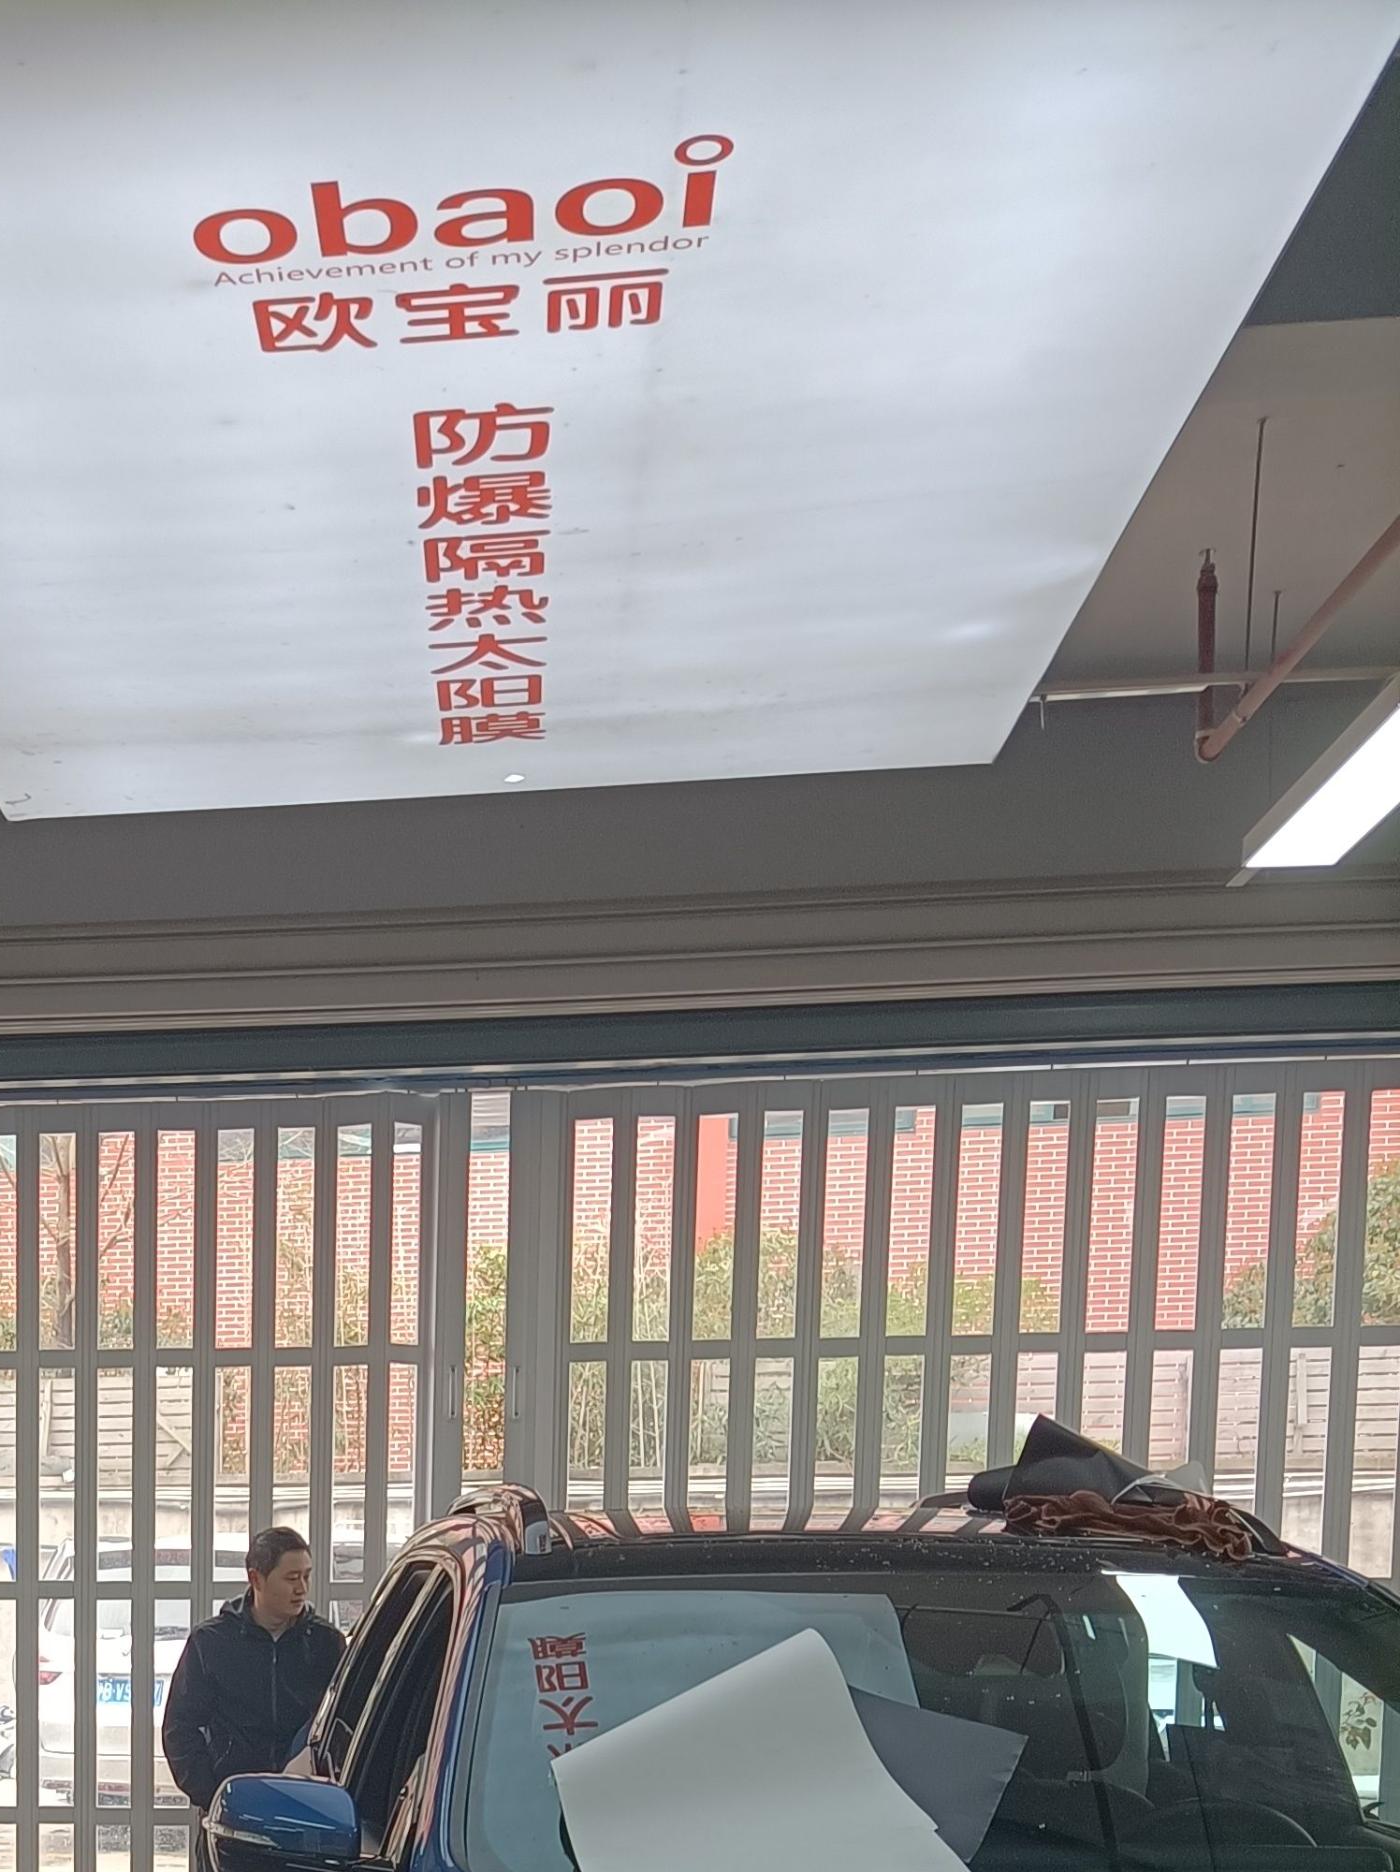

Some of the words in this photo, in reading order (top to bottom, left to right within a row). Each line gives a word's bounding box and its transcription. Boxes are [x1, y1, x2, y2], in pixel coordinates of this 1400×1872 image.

[193, 134, 734, 265] obaoi
[214, 257, 433, 287] Achievement
[446, 251, 479, 269] of
[491, 250, 542, 267] my
[555, 235, 710, 263] splendor
[252, 267, 670, 353] 欧宝丽
[412, 402, 555, 746] 防爆隔热太阳膜
